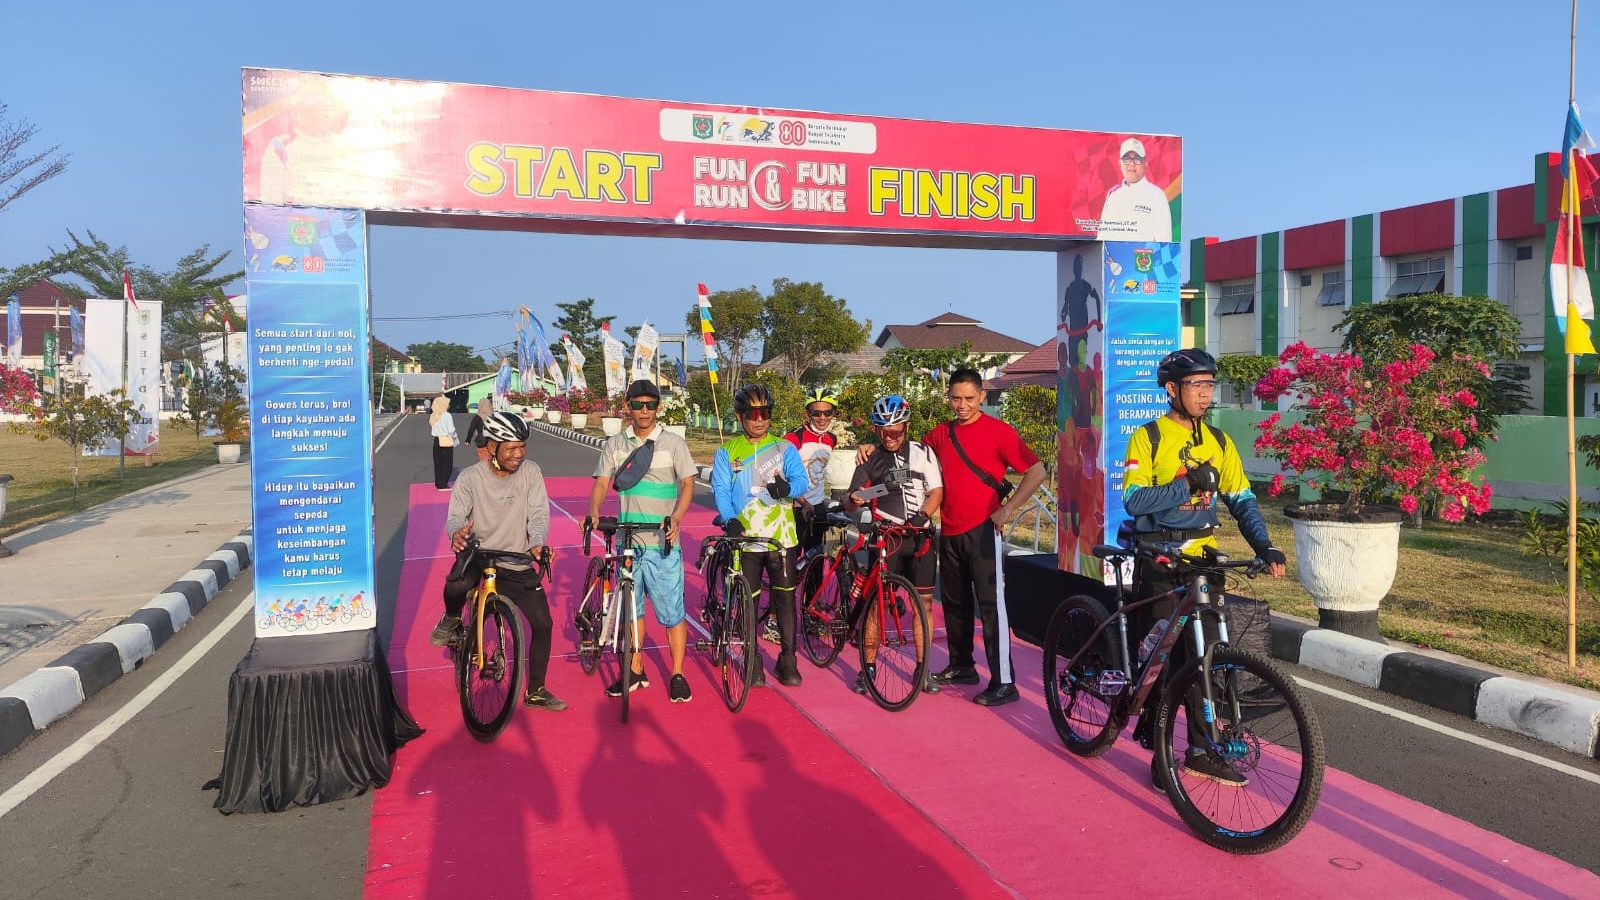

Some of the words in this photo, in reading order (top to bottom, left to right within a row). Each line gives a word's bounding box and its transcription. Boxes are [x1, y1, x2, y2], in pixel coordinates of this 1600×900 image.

[778, 119, 806, 146] 80
[465, 142, 663, 204] START
[693, 156, 747, 181] FUN
[797, 161, 847, 186] FUN
[695, 184, 749, 209] RUN
[868, 166, 1037, 222] FINISH
[792, 188, 848, 213] BIKE
[302, 255, 324, 273] 80
[255, 329, 287, 338] Semua
[290, 329, 313, 338] start
[316, 329, 335, 338] dari
[259, 345, 282, 354] yang
[285, 343, 321, 354] penting
[324, 343, 333, 352] lo
[335, 344, 353, 353] gak
[259, 358, 299, 366] berhenti
[1116, 358, 1137, 367] dengan
[265, 401, 297, 409] Gowes
[300, 401, 329, 410] terus,
[332, 400, 351, 409] bro!
[1115, 394, 1152, 404] POSTING
[262, 415, 271, 424] di
[273, 415, 293, 425] tiap
[296, 414, 336, 424] kayuhan
[338, 414, 356, 422] ada
[271, 429, 310, 440] langkah
[313, 428, 347, 438] menuju
[291, 443, 328, 452] sukses!
[265, 482, 293, 493] Hidup
[296, 482, 309, 491] itu
[312, 481, 356, 492] bagaikan
[279, 495, 342, 507] mengendarai
[294, 510, 328, 520] sepeda
[276, 525, 303, 535] untuk
[306, 523, 346, 535] menjaga
[277, 538, 346, 549] keseimbangan
[284, 553, 310, 563] kamu
[313, 552, 340, 561] harus
[282, 567, 308, 578] tetap
[311, 565, 343, 575] melaju
